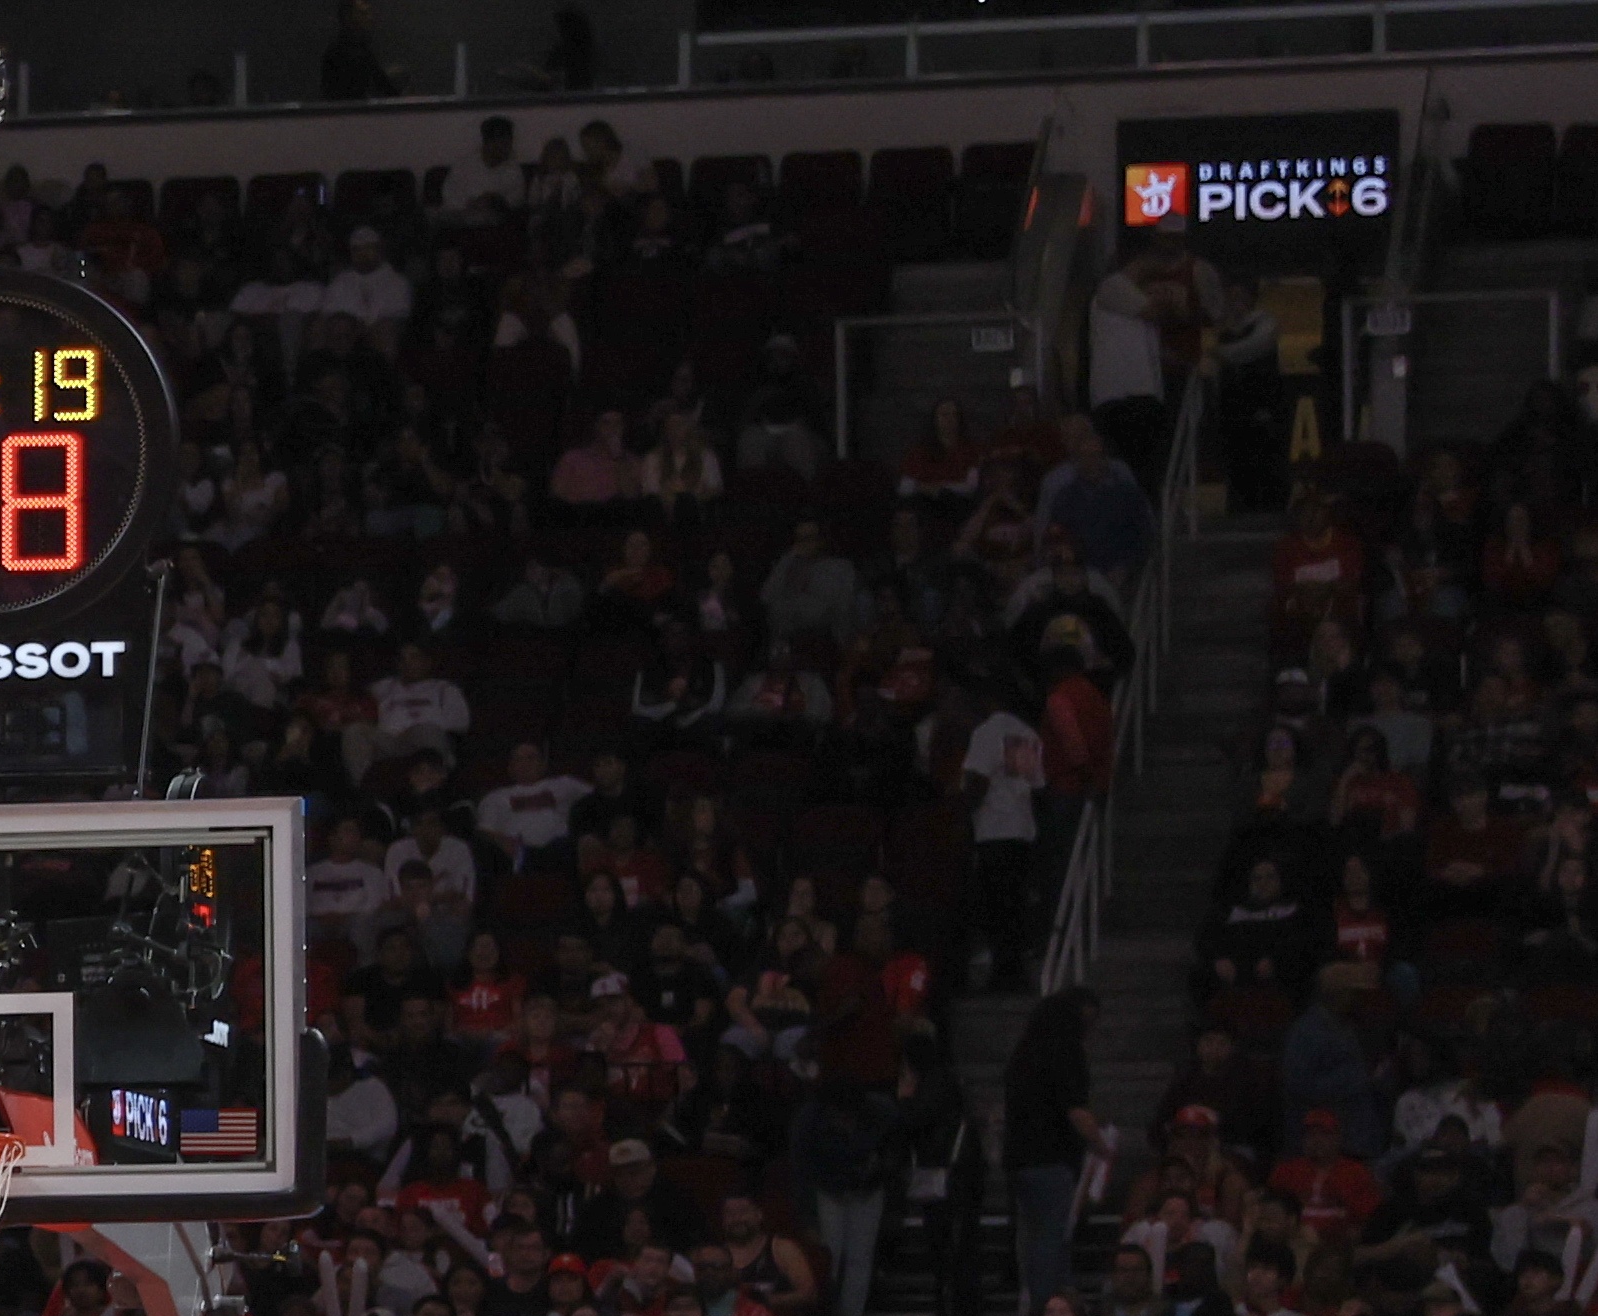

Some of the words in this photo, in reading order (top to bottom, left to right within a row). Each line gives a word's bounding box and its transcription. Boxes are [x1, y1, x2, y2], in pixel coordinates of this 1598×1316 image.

[1197, 154, 1388, 182] DRAFTKINGS
[1197, 177, 1328, 223] PICK
[1351, 176, 1389, 218] 6
[124, 1090, 155, 1144] PICK
[157, 1099, 168, 1146] 6
